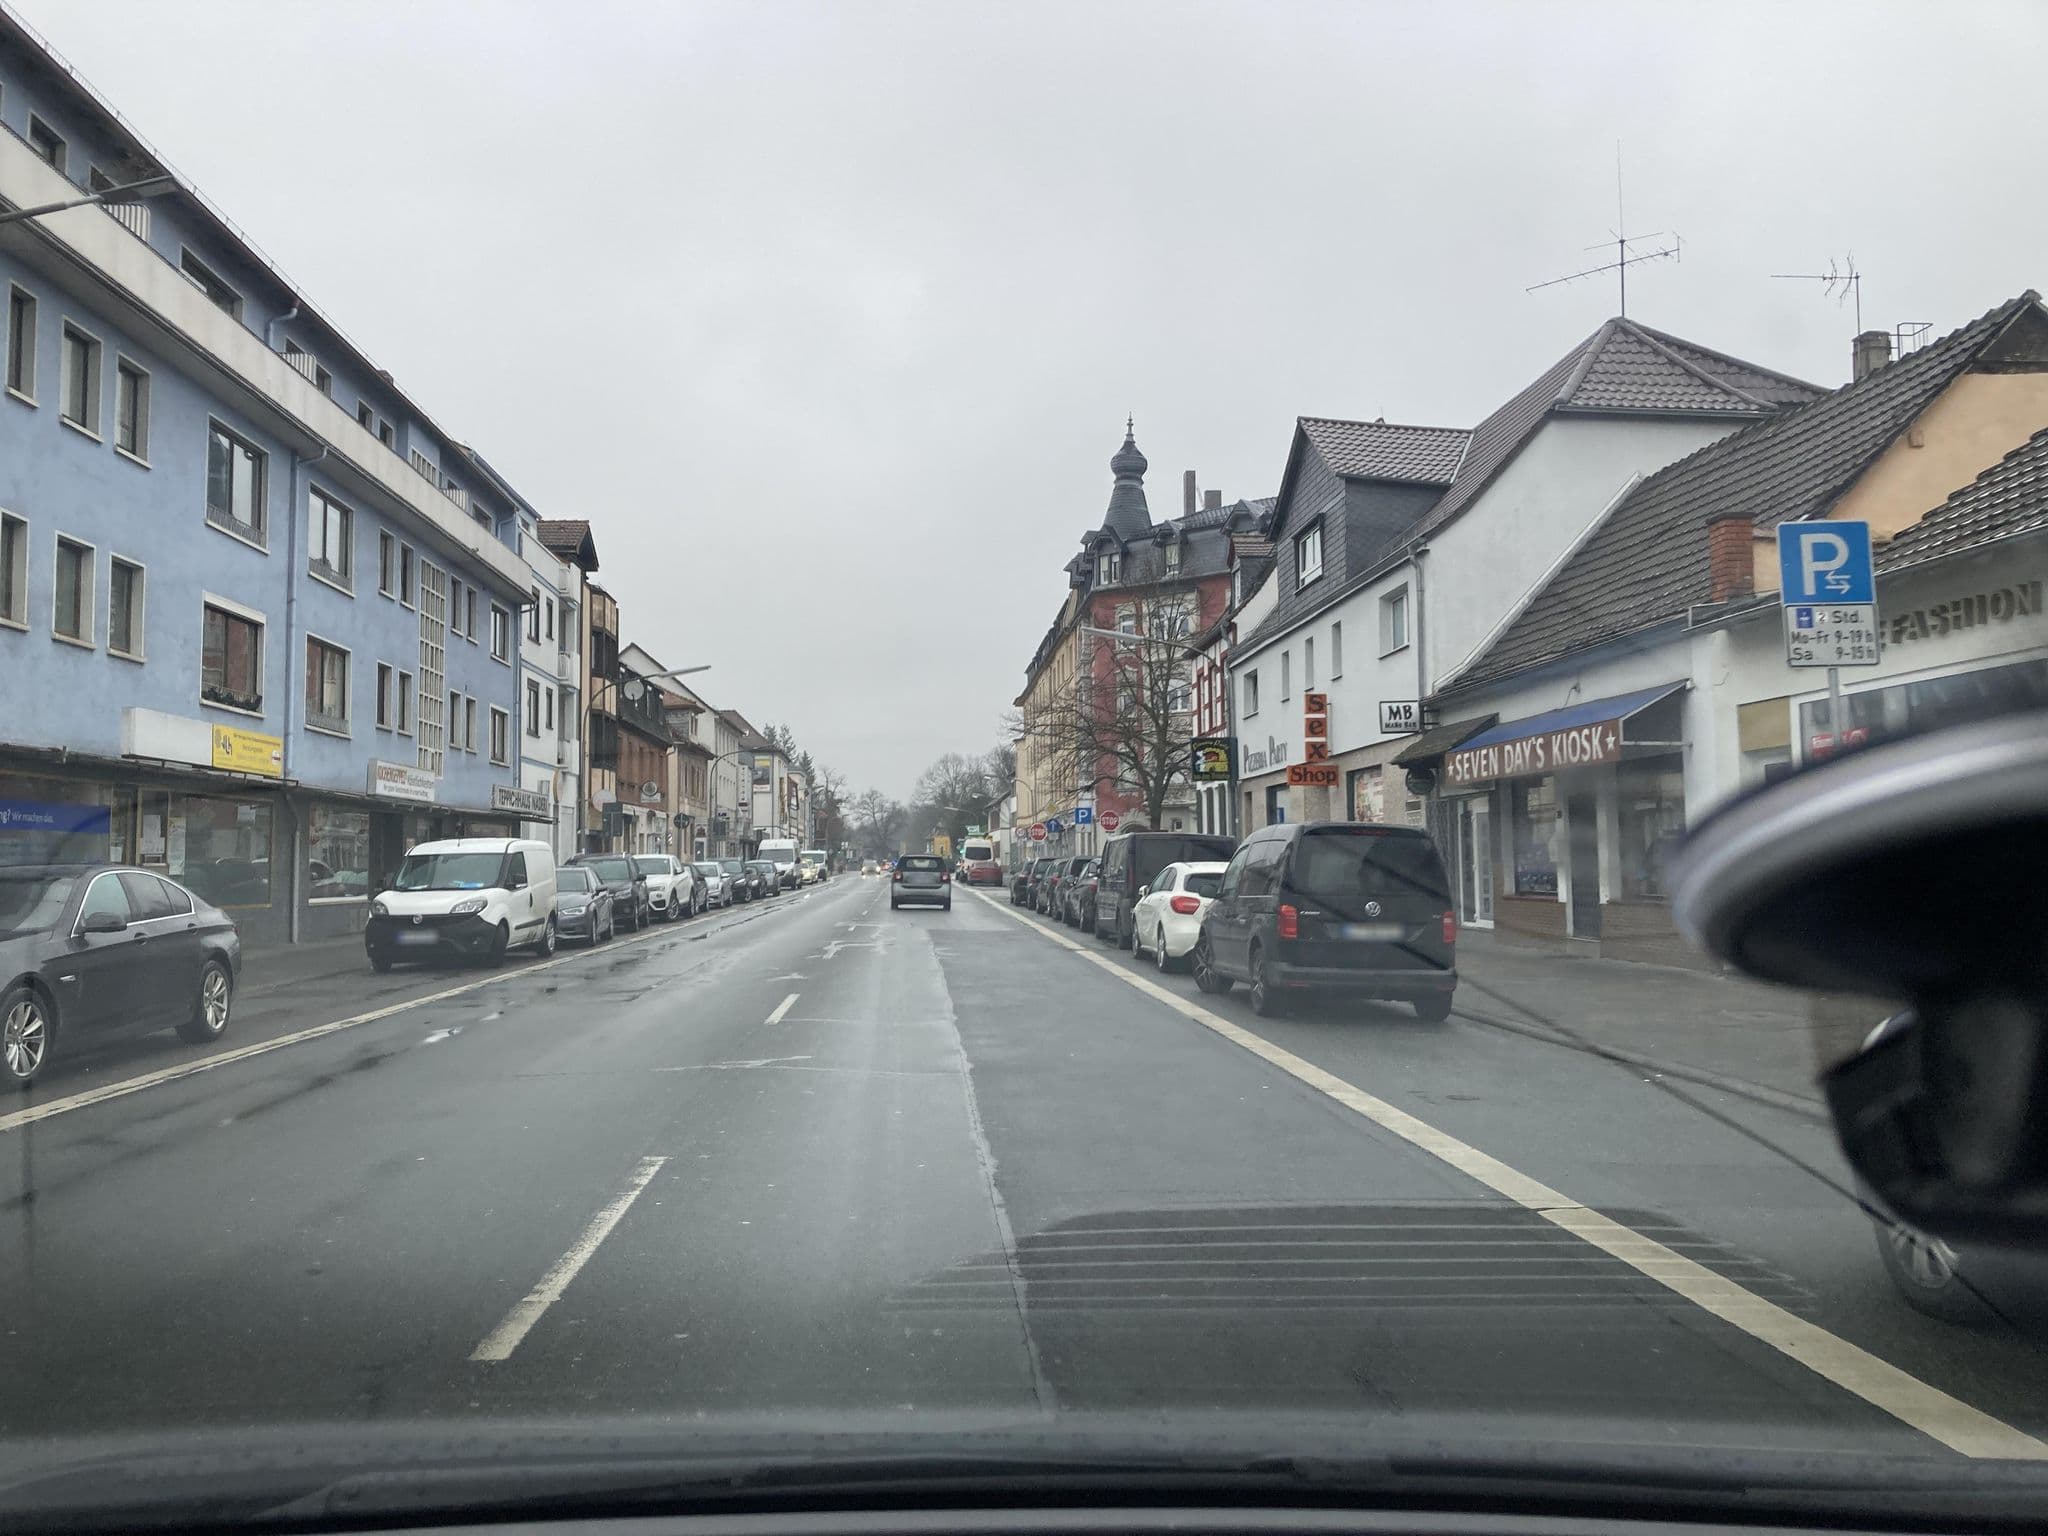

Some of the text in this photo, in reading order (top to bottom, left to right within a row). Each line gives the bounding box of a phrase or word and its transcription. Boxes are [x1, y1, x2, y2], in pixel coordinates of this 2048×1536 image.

[1800, 533, 1849, 596] P
[1831, 609, 1865, 624] Std.
[1791, 630, 1831, 644] Mo-Fr
[1791, 647, 1813, 661] Sa
[1387, 705, 1412, 721] MB
[1455, 726, 1604, 782] SEVEN DAY'S KIOSK
[1290, 765, 1337, 784] Shop
[1078, 810, 1088, 823] P
[1101, 816, 1118, 824] STOP
